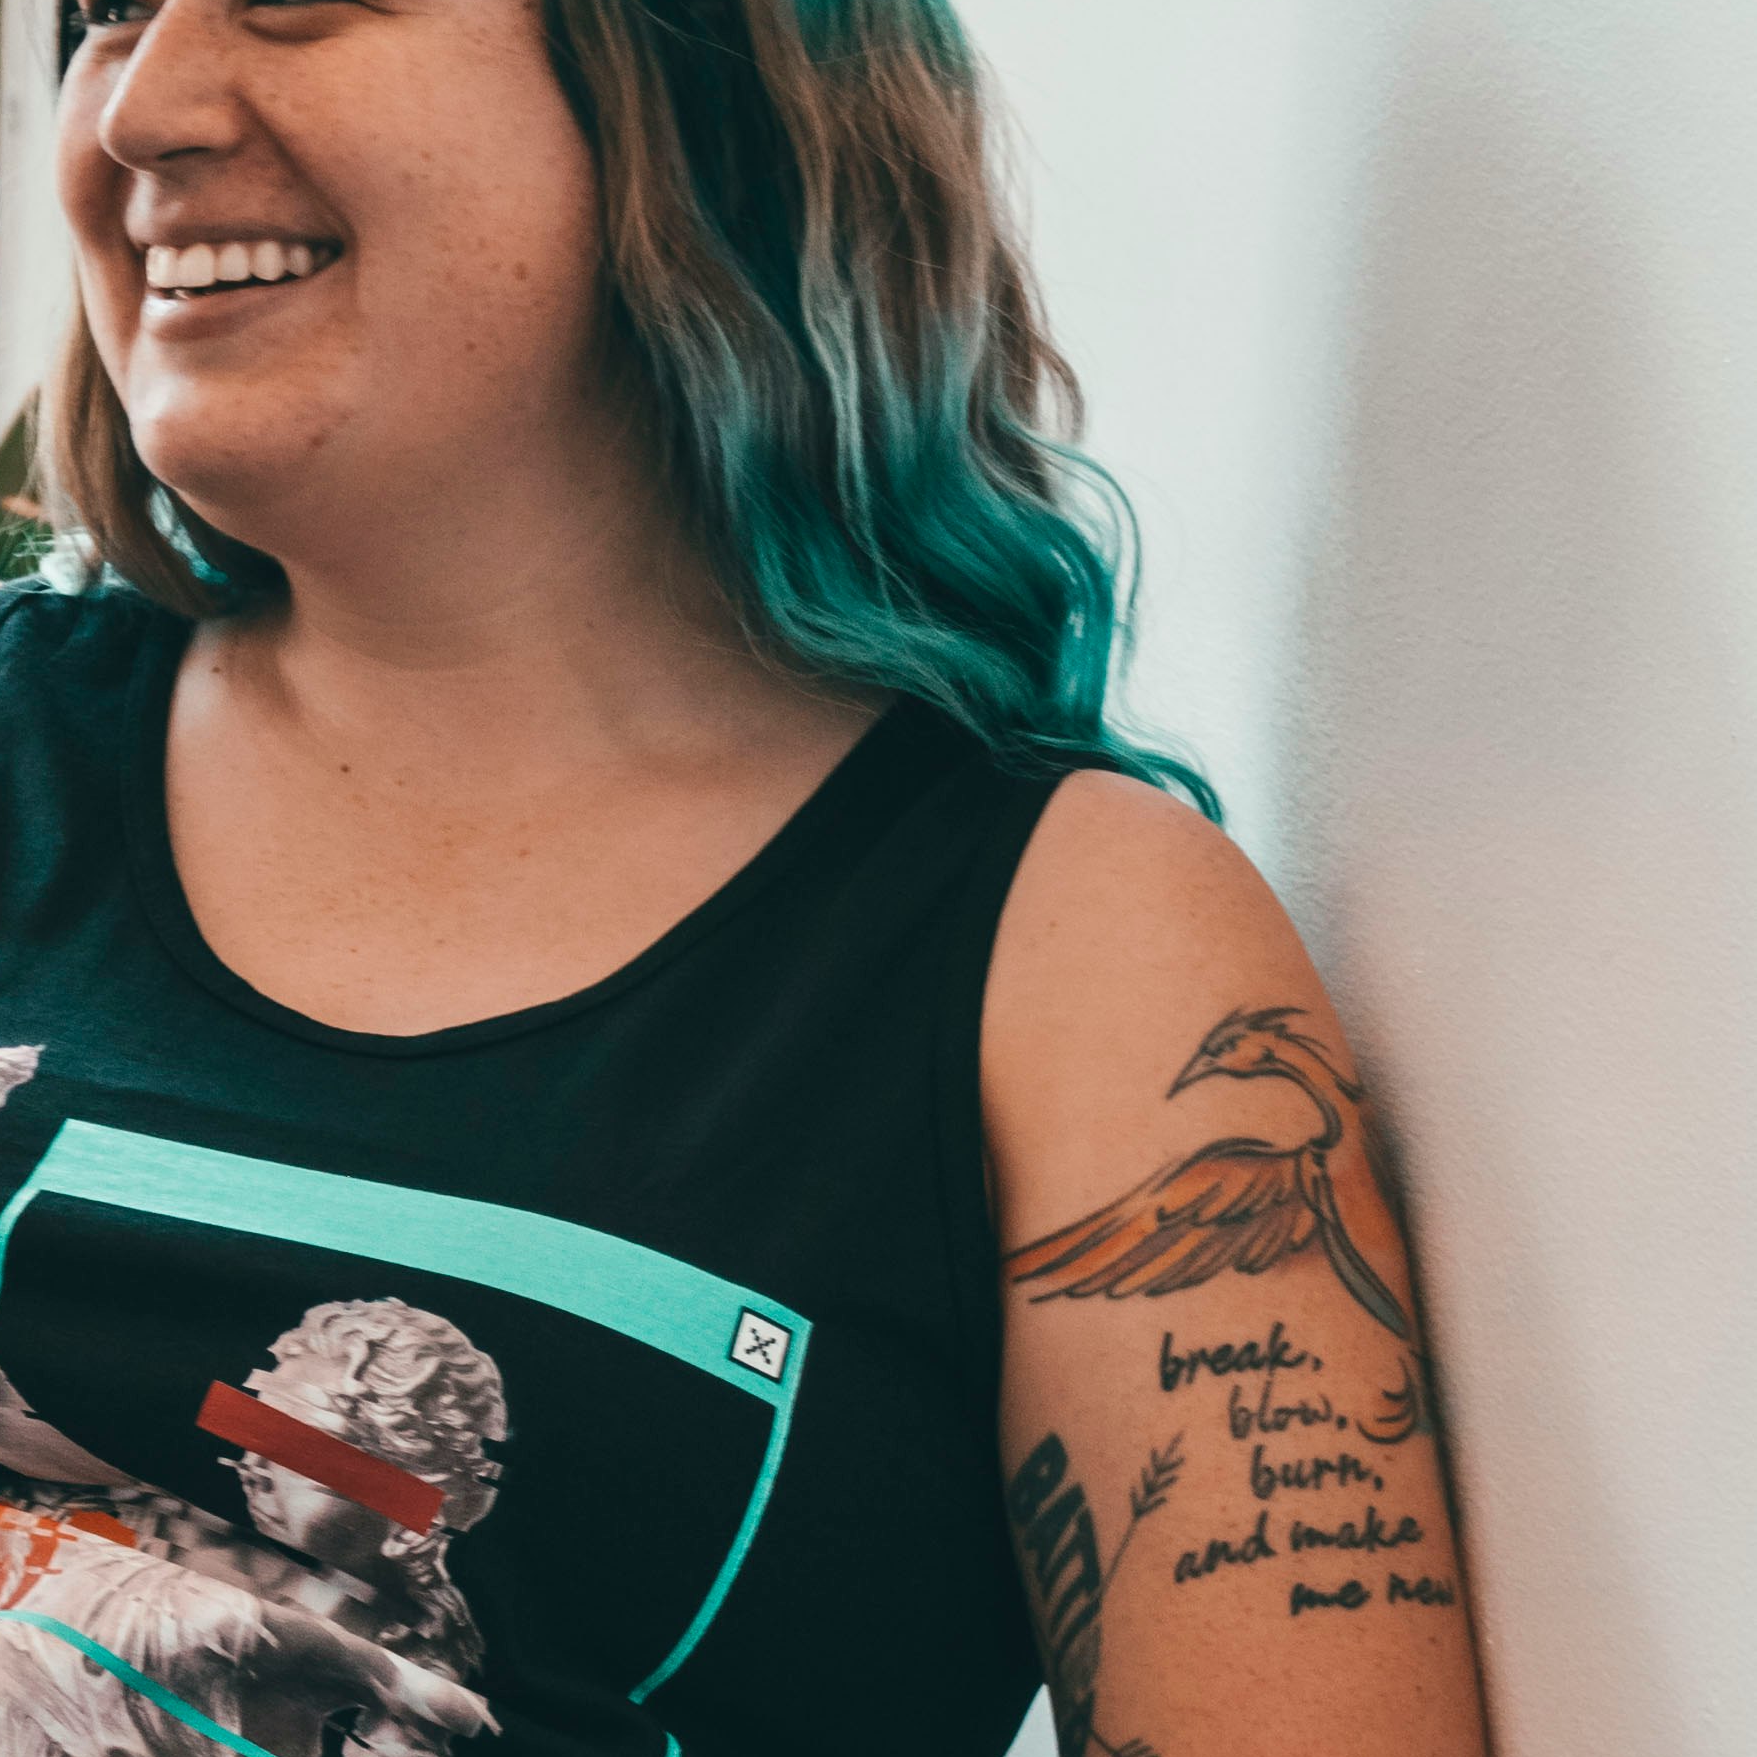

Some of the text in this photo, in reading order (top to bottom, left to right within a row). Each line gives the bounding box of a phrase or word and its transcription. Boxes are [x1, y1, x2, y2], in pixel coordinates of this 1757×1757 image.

[1174, 1505, 1424, 1584] and make
[1290, 1579, 1372, 1617] me
